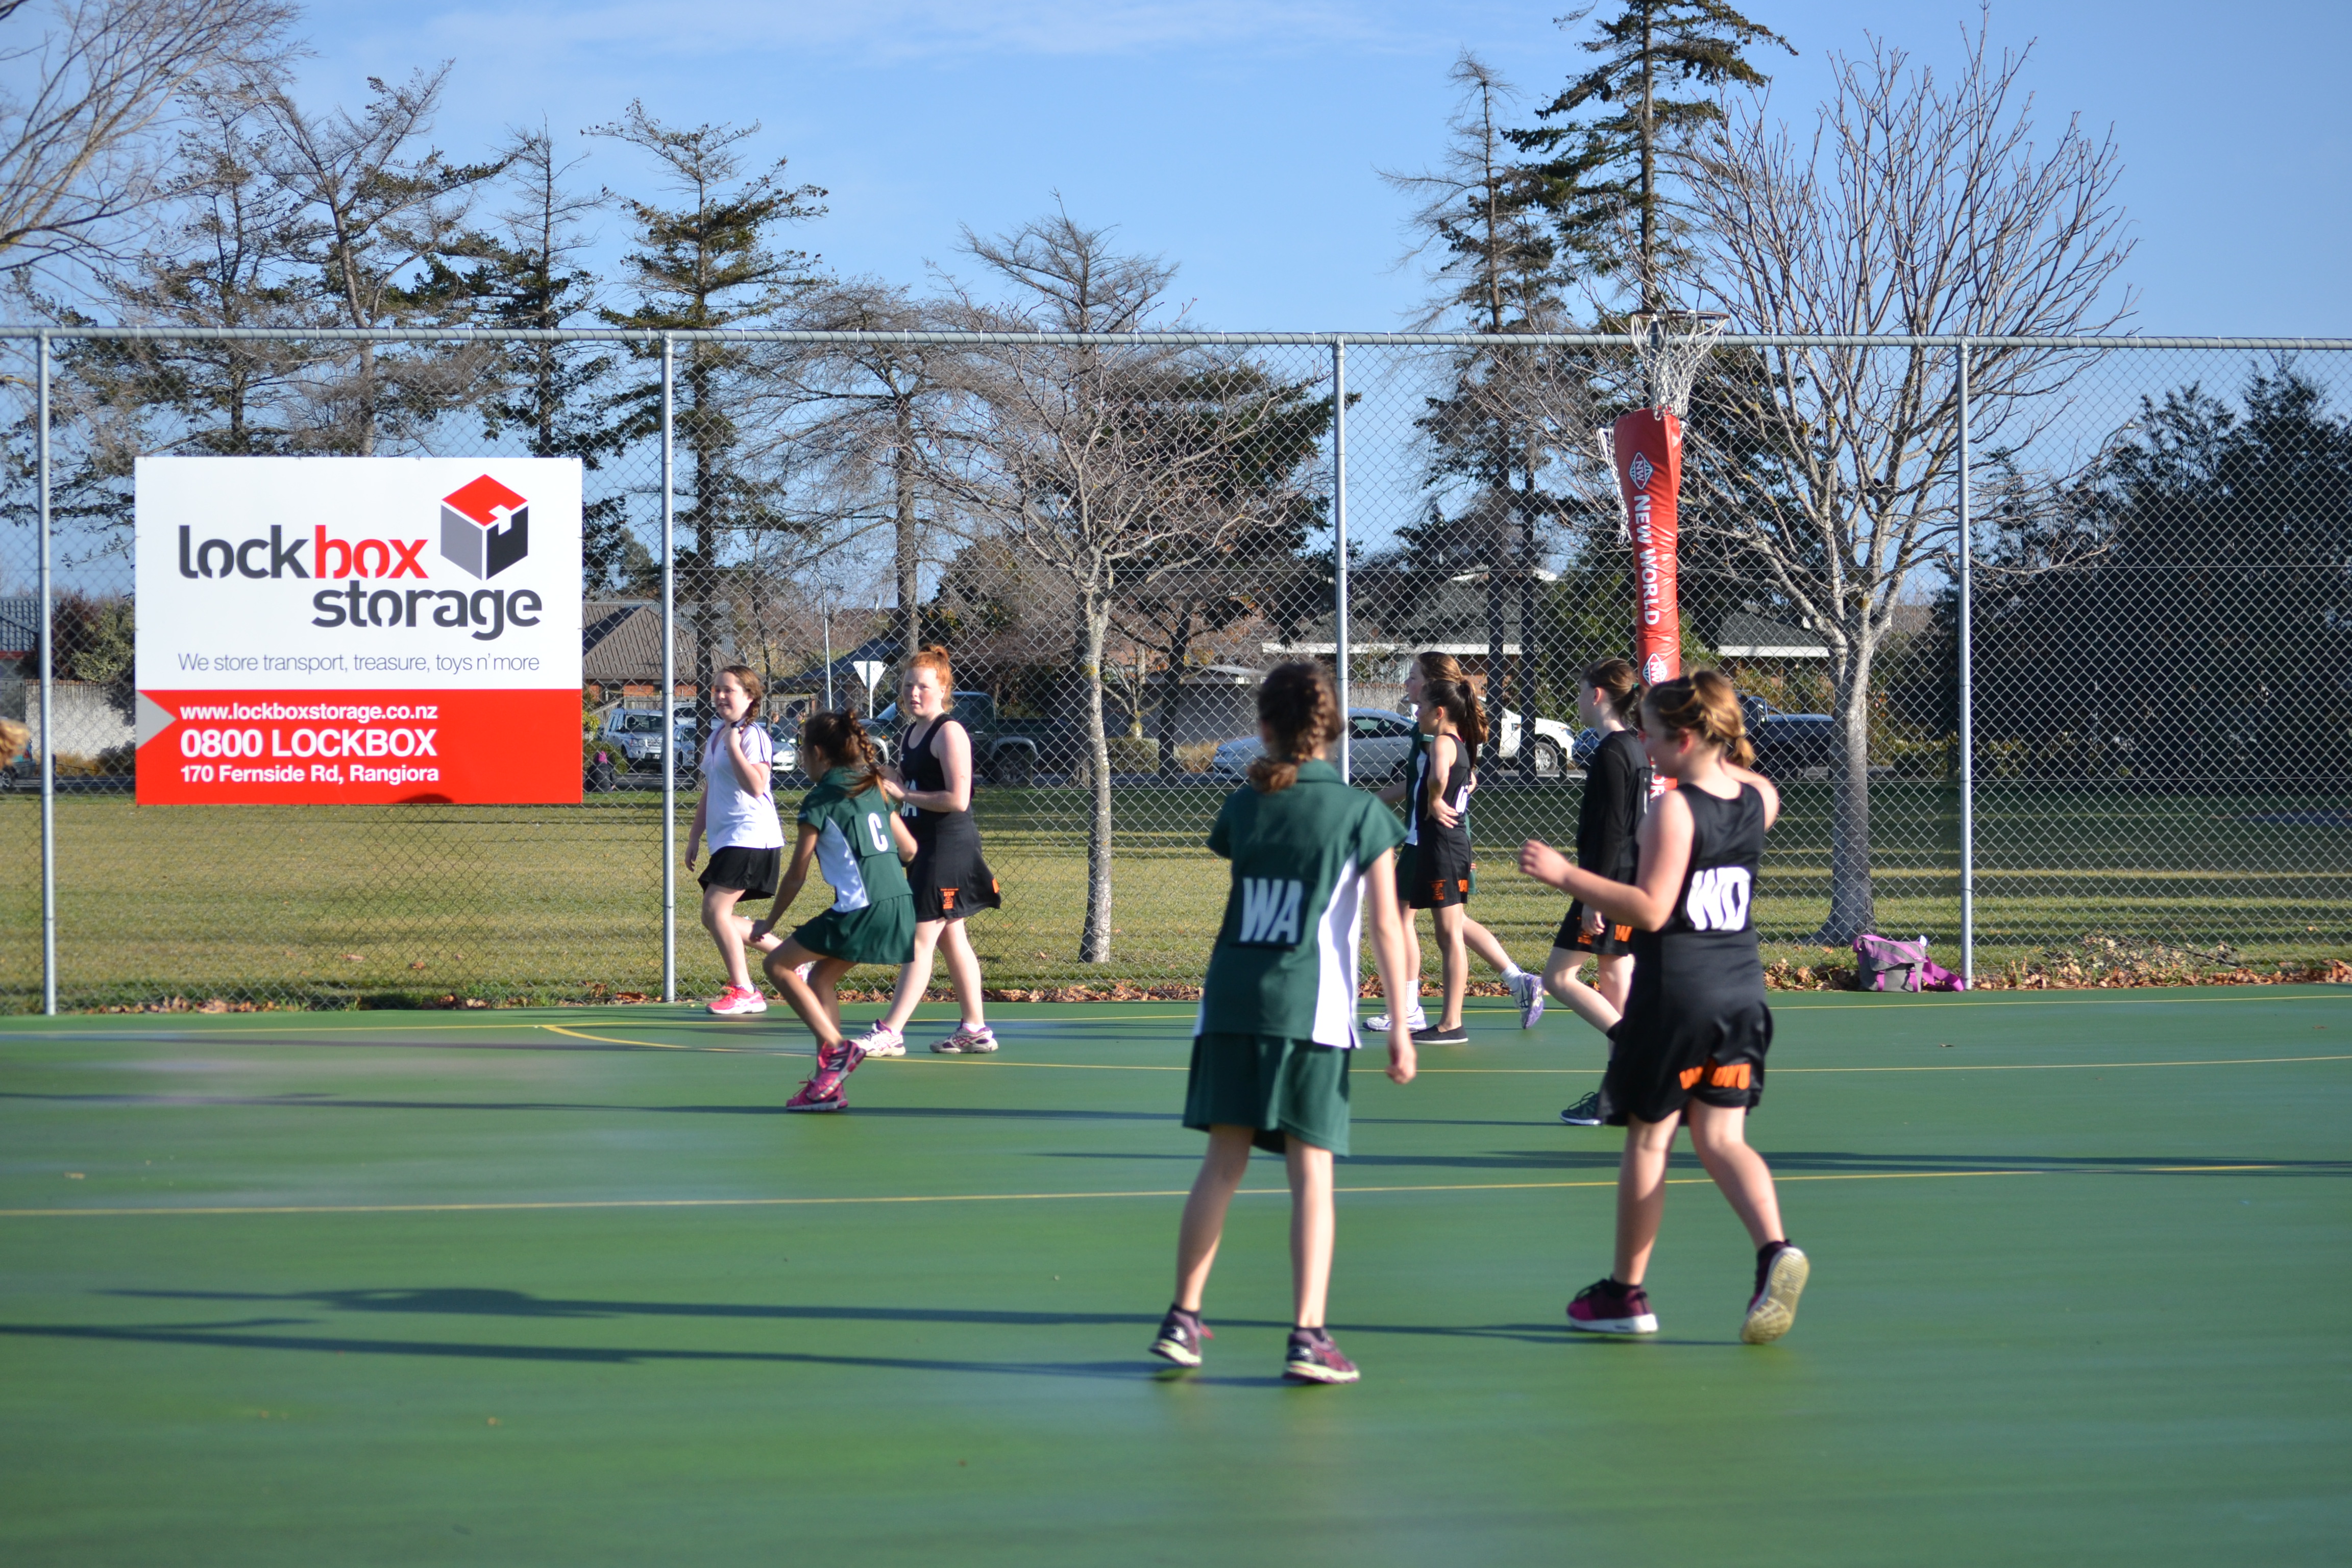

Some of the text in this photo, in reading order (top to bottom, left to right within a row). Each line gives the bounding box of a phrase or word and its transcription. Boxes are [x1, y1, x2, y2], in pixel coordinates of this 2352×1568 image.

[179, 525, 430, 579] lockbox
[1634, 494, 1660, 625] NEW WORLD
[311, 580, 543, 641] storage
[178, 653, 209, 671] We
[214, 654, 258, 671] store
[263, 654, 348, 675] transport,
[353, 654, 430, 673] treasure,
[435, 654, 473, 675] toys
[180, 702, 438, 724] www.lockboxstorage.co.nz
[181, 728, 437, 757] 0800 LOCKBOX
[181, 765, 439, 785] 170 Fernside Rd, Rangiora
[868, 813, 888, 851] C
[1239, 877, 1303, 943] WA
